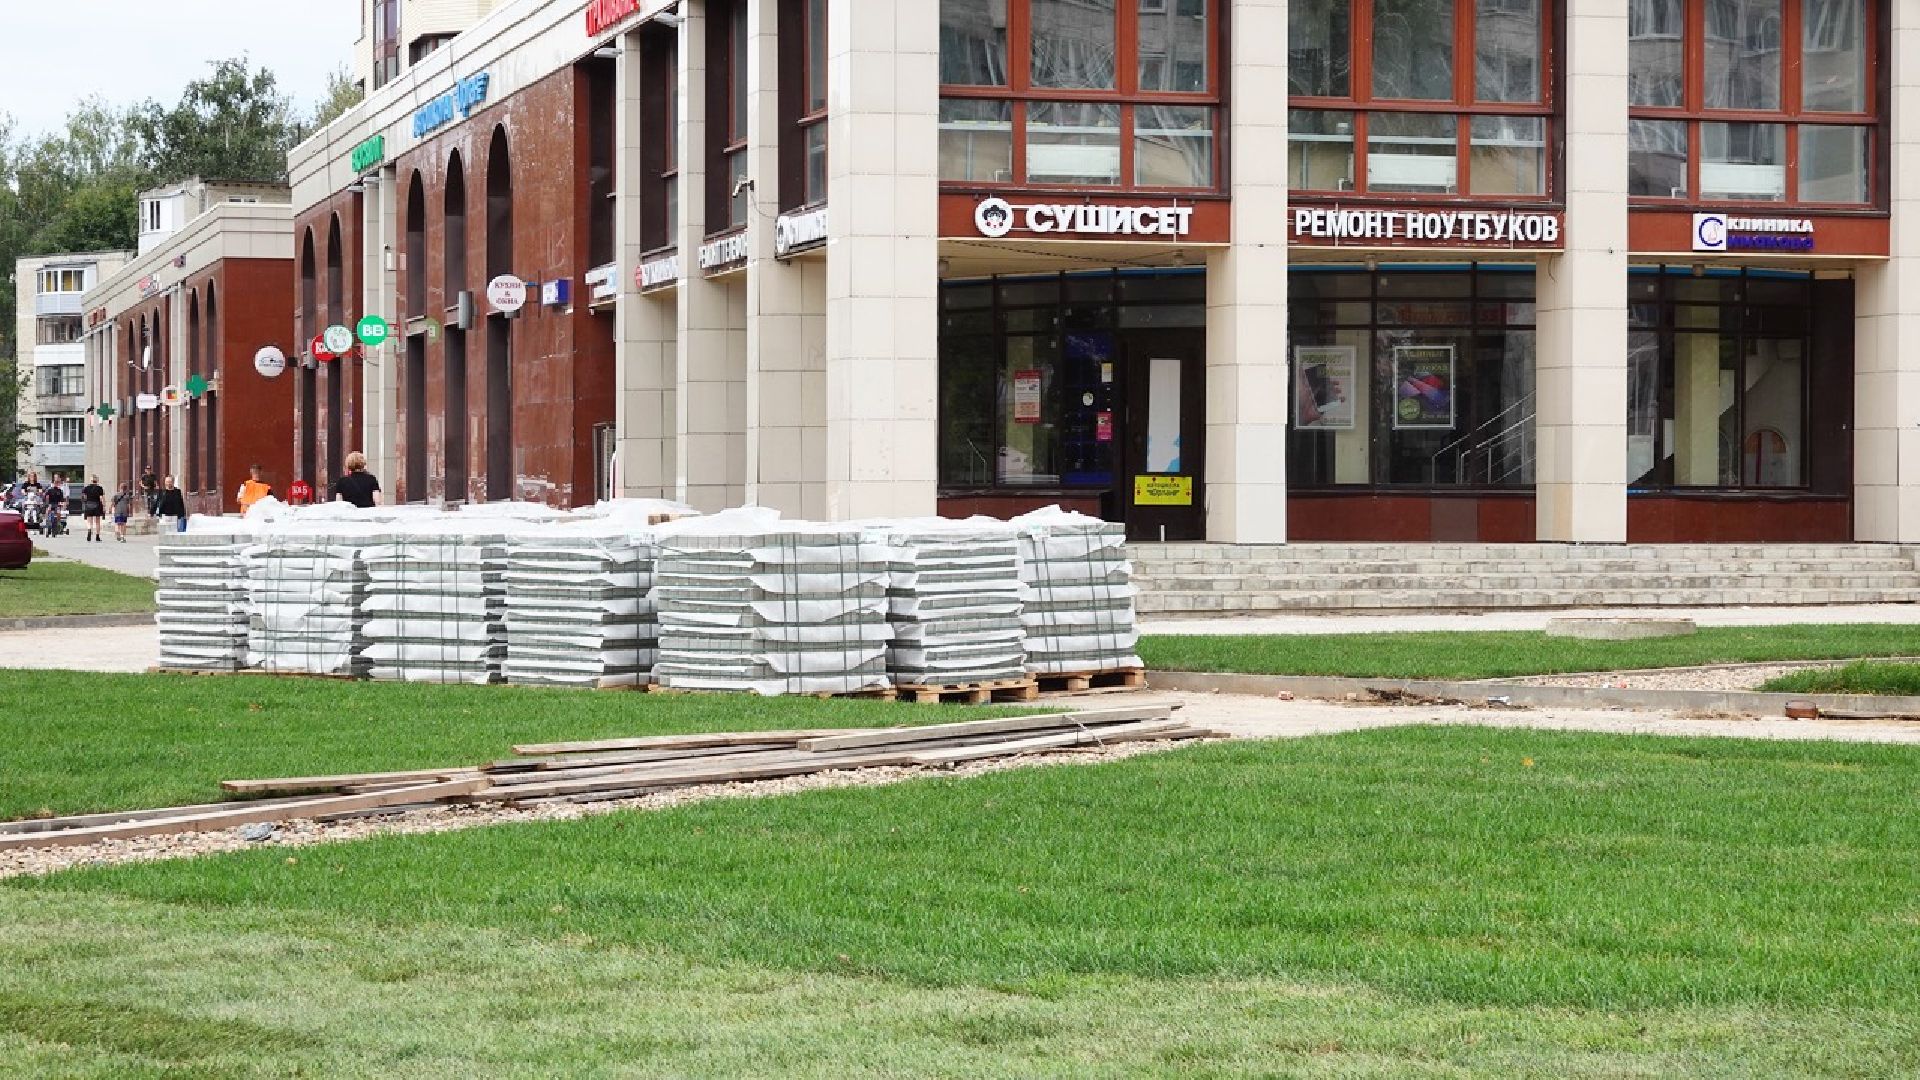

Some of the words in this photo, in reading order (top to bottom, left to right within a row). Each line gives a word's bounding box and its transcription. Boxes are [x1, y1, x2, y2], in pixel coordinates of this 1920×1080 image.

[1026, 204, 1193, 234] СУШИСЕТ
[1296, 210, 1400, 238] РЕМОНТ
[1406, 212, 1558, 241] НОУТБУКОВ
[1728, 218, 1814, 232] КЛИНИКА
